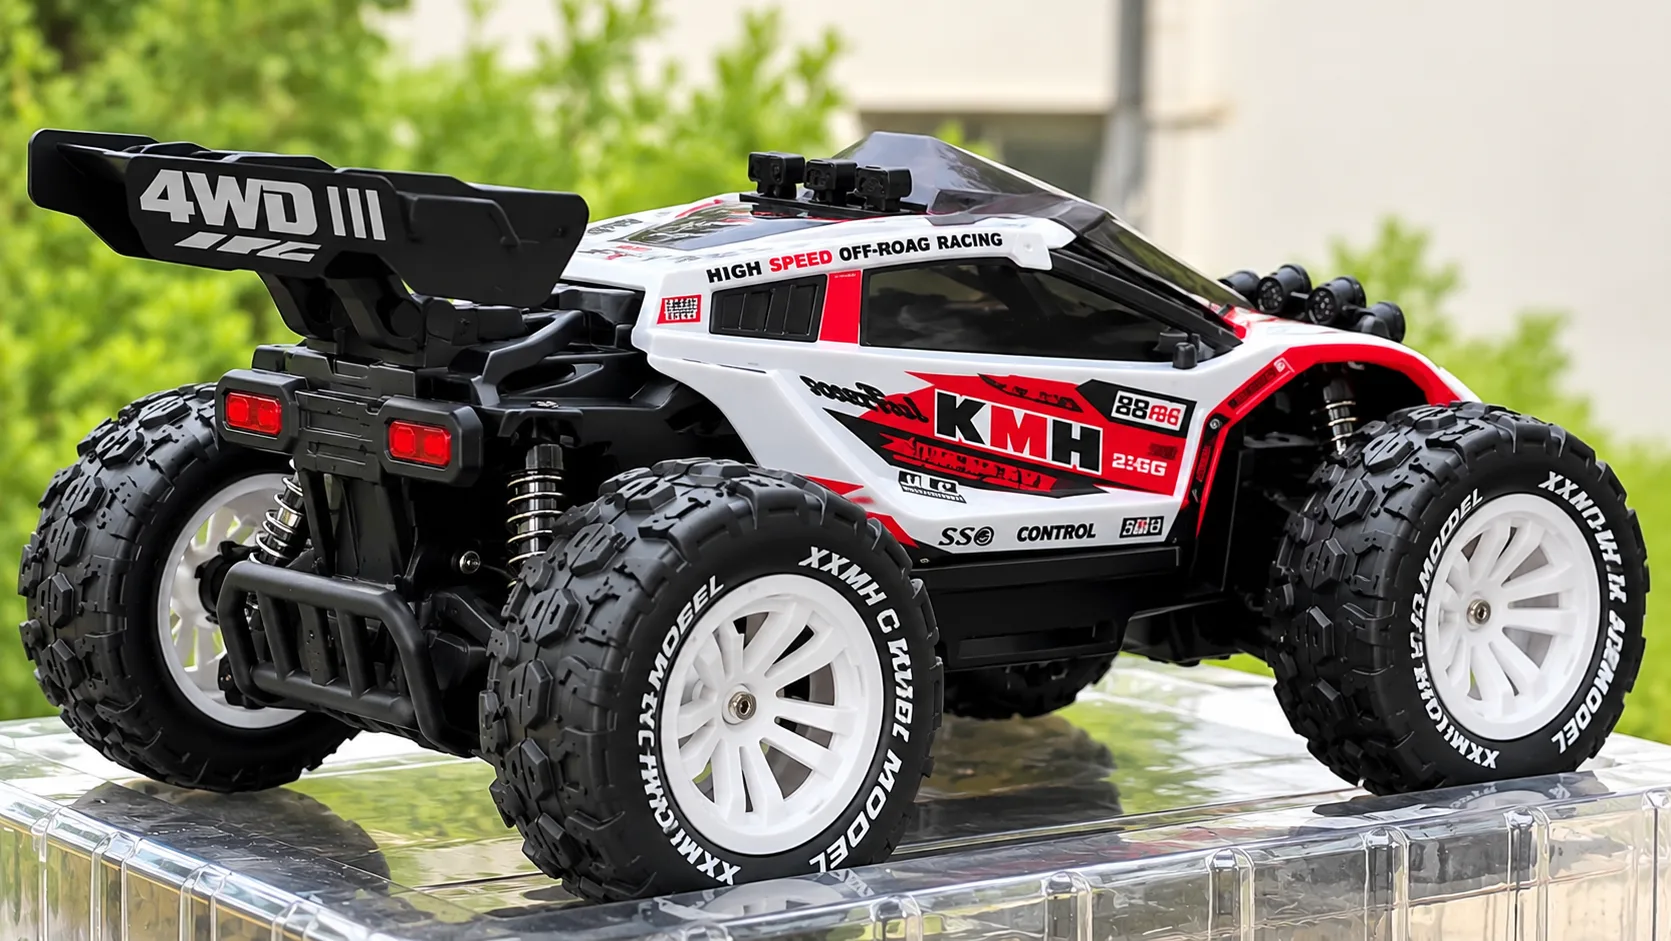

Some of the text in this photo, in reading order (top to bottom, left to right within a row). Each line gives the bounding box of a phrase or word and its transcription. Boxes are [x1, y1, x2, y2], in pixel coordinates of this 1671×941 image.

[140, 169, 318, 236] 4WD
[707, 261, 762, 283] HIGH
[769, 249, 833, 272] SPEED
[937, 232, 1003, 250] RACING
[935, 390, 1102, 474] KMH
[1016, 523, 1097, 542] CONTROL
[809, 748, 902, 873] MODEL
